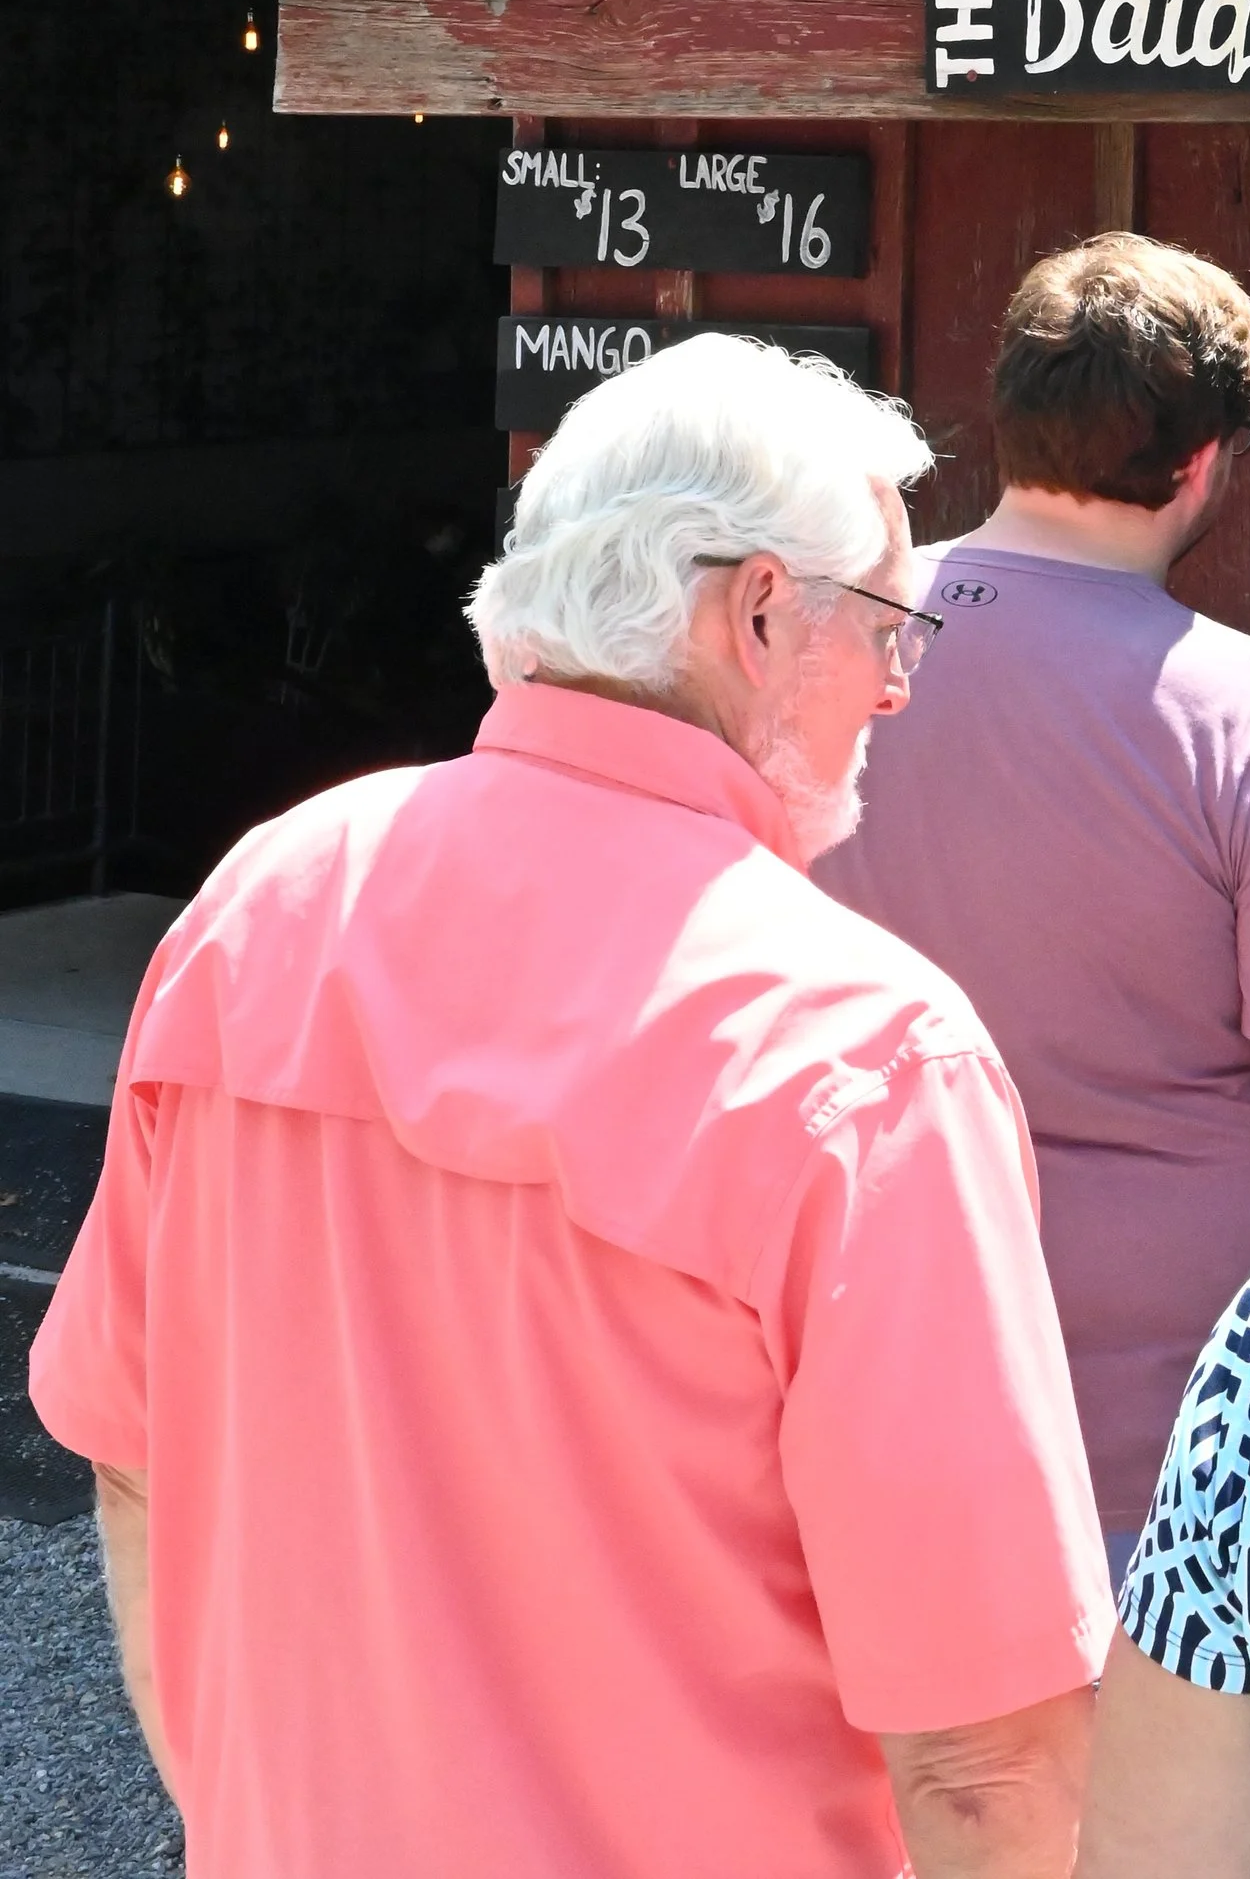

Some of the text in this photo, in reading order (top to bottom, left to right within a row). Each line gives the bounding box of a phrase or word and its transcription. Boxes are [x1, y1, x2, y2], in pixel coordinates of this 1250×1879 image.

[502, 150, 769, 194] SMALL: LARGE
[574, 188, 832, 269] $13 $16
[515, 324, 652, 375] MANGO
